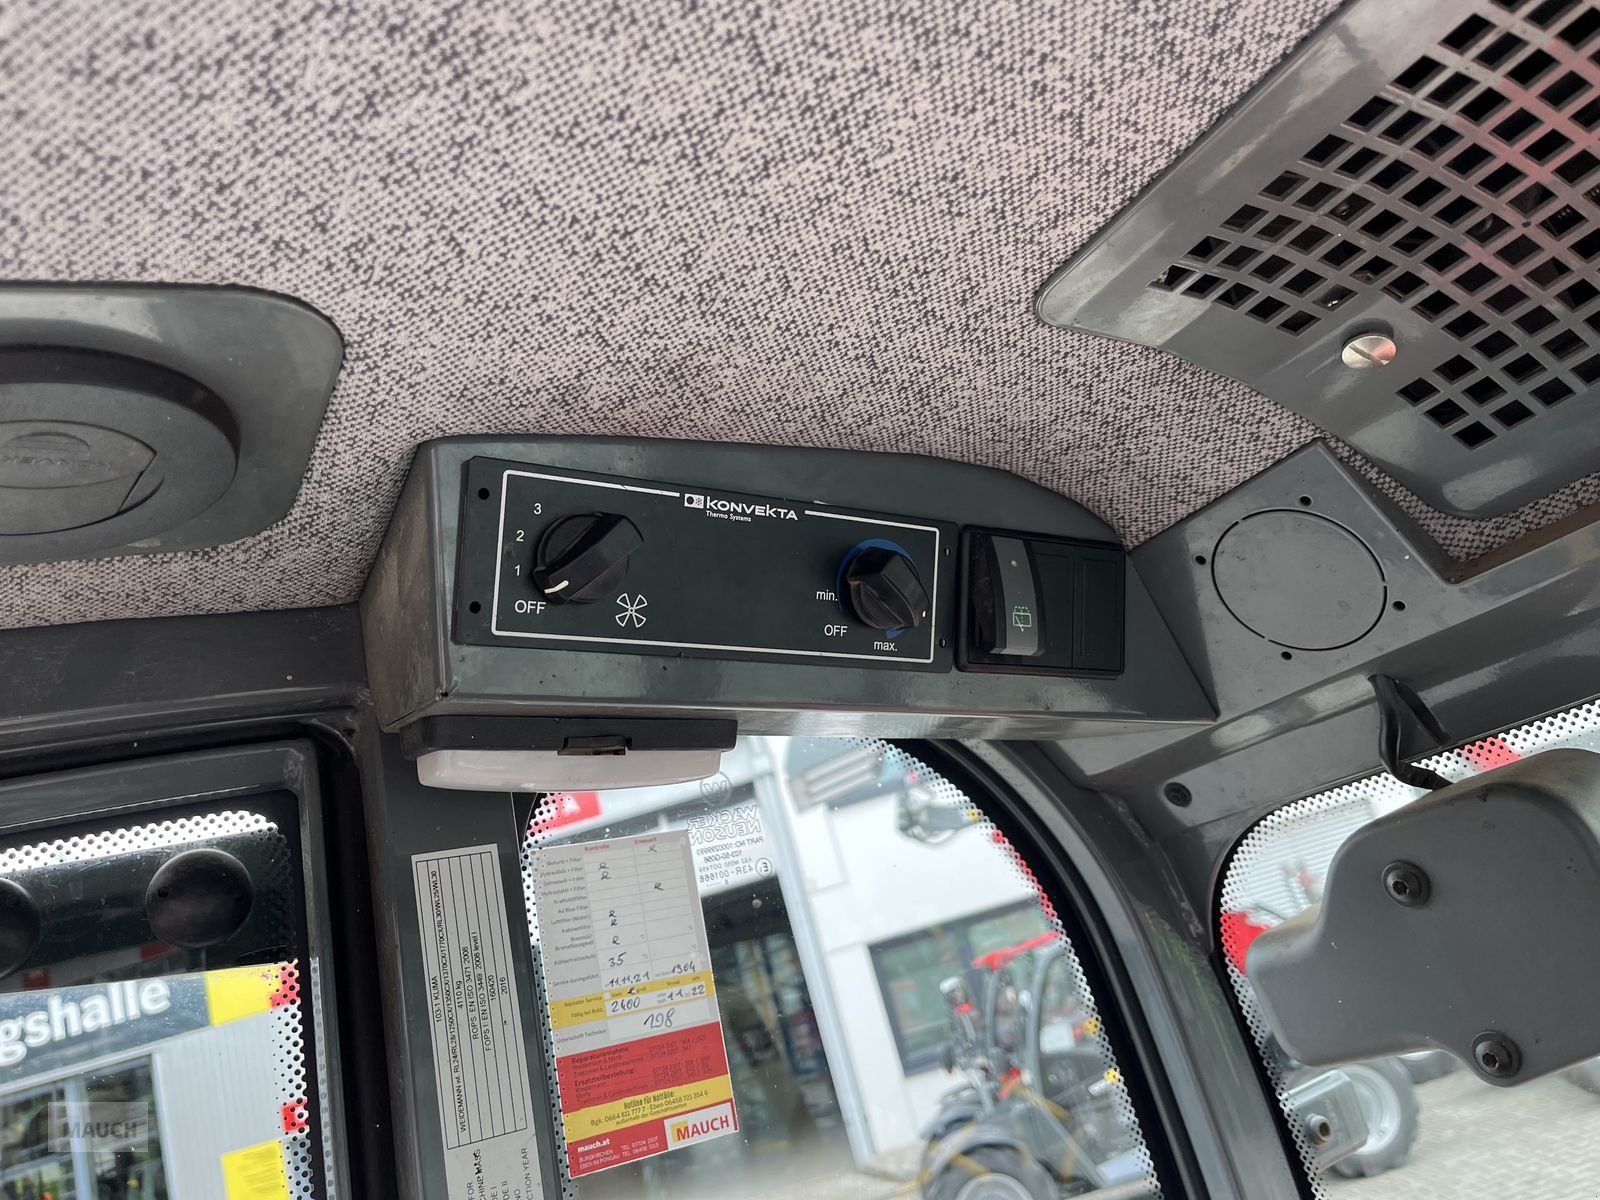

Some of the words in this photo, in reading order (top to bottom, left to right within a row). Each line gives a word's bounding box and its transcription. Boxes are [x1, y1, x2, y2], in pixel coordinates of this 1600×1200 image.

[533, 503, 542, 515] 3
[706, 496, 798, 520] KONVEKTA
[706, 510, 728, 519] Thermo
[729, 513, 752, 522] Systems
[516, 530, 525, 542] 2
[514, 565, 520, 576] 1
[816, 589, 838, 601] min.
[514, 600, 546, 615] OFF
[824, 624, 848, 637] OFF
[873, 641, 898, 651] max.
[608, 952, 627, 967] 35
[432, 976, 440, 1000] KLIMA
[455, 980, 462, 991] kg
[488, 975, 496, 1000] 160420
[434, 1003, 442, 1022] 103-1
[469, 1001, 476, 1012] EN
[481, 1009, 488, 1020] EN
[0, 979, 171, 1066] gshalle
[483, 1028, 491, 1051] FOPS
[456, 1084, 466, 1133] WEIDEMANN
[676, 1115, 729, 1141] MAUCH
[577, 1138, 610, 1153] mauch.at
[521, 1147, 529, 1171] YEAR
[467, 1181, 475, 1200] FOR
